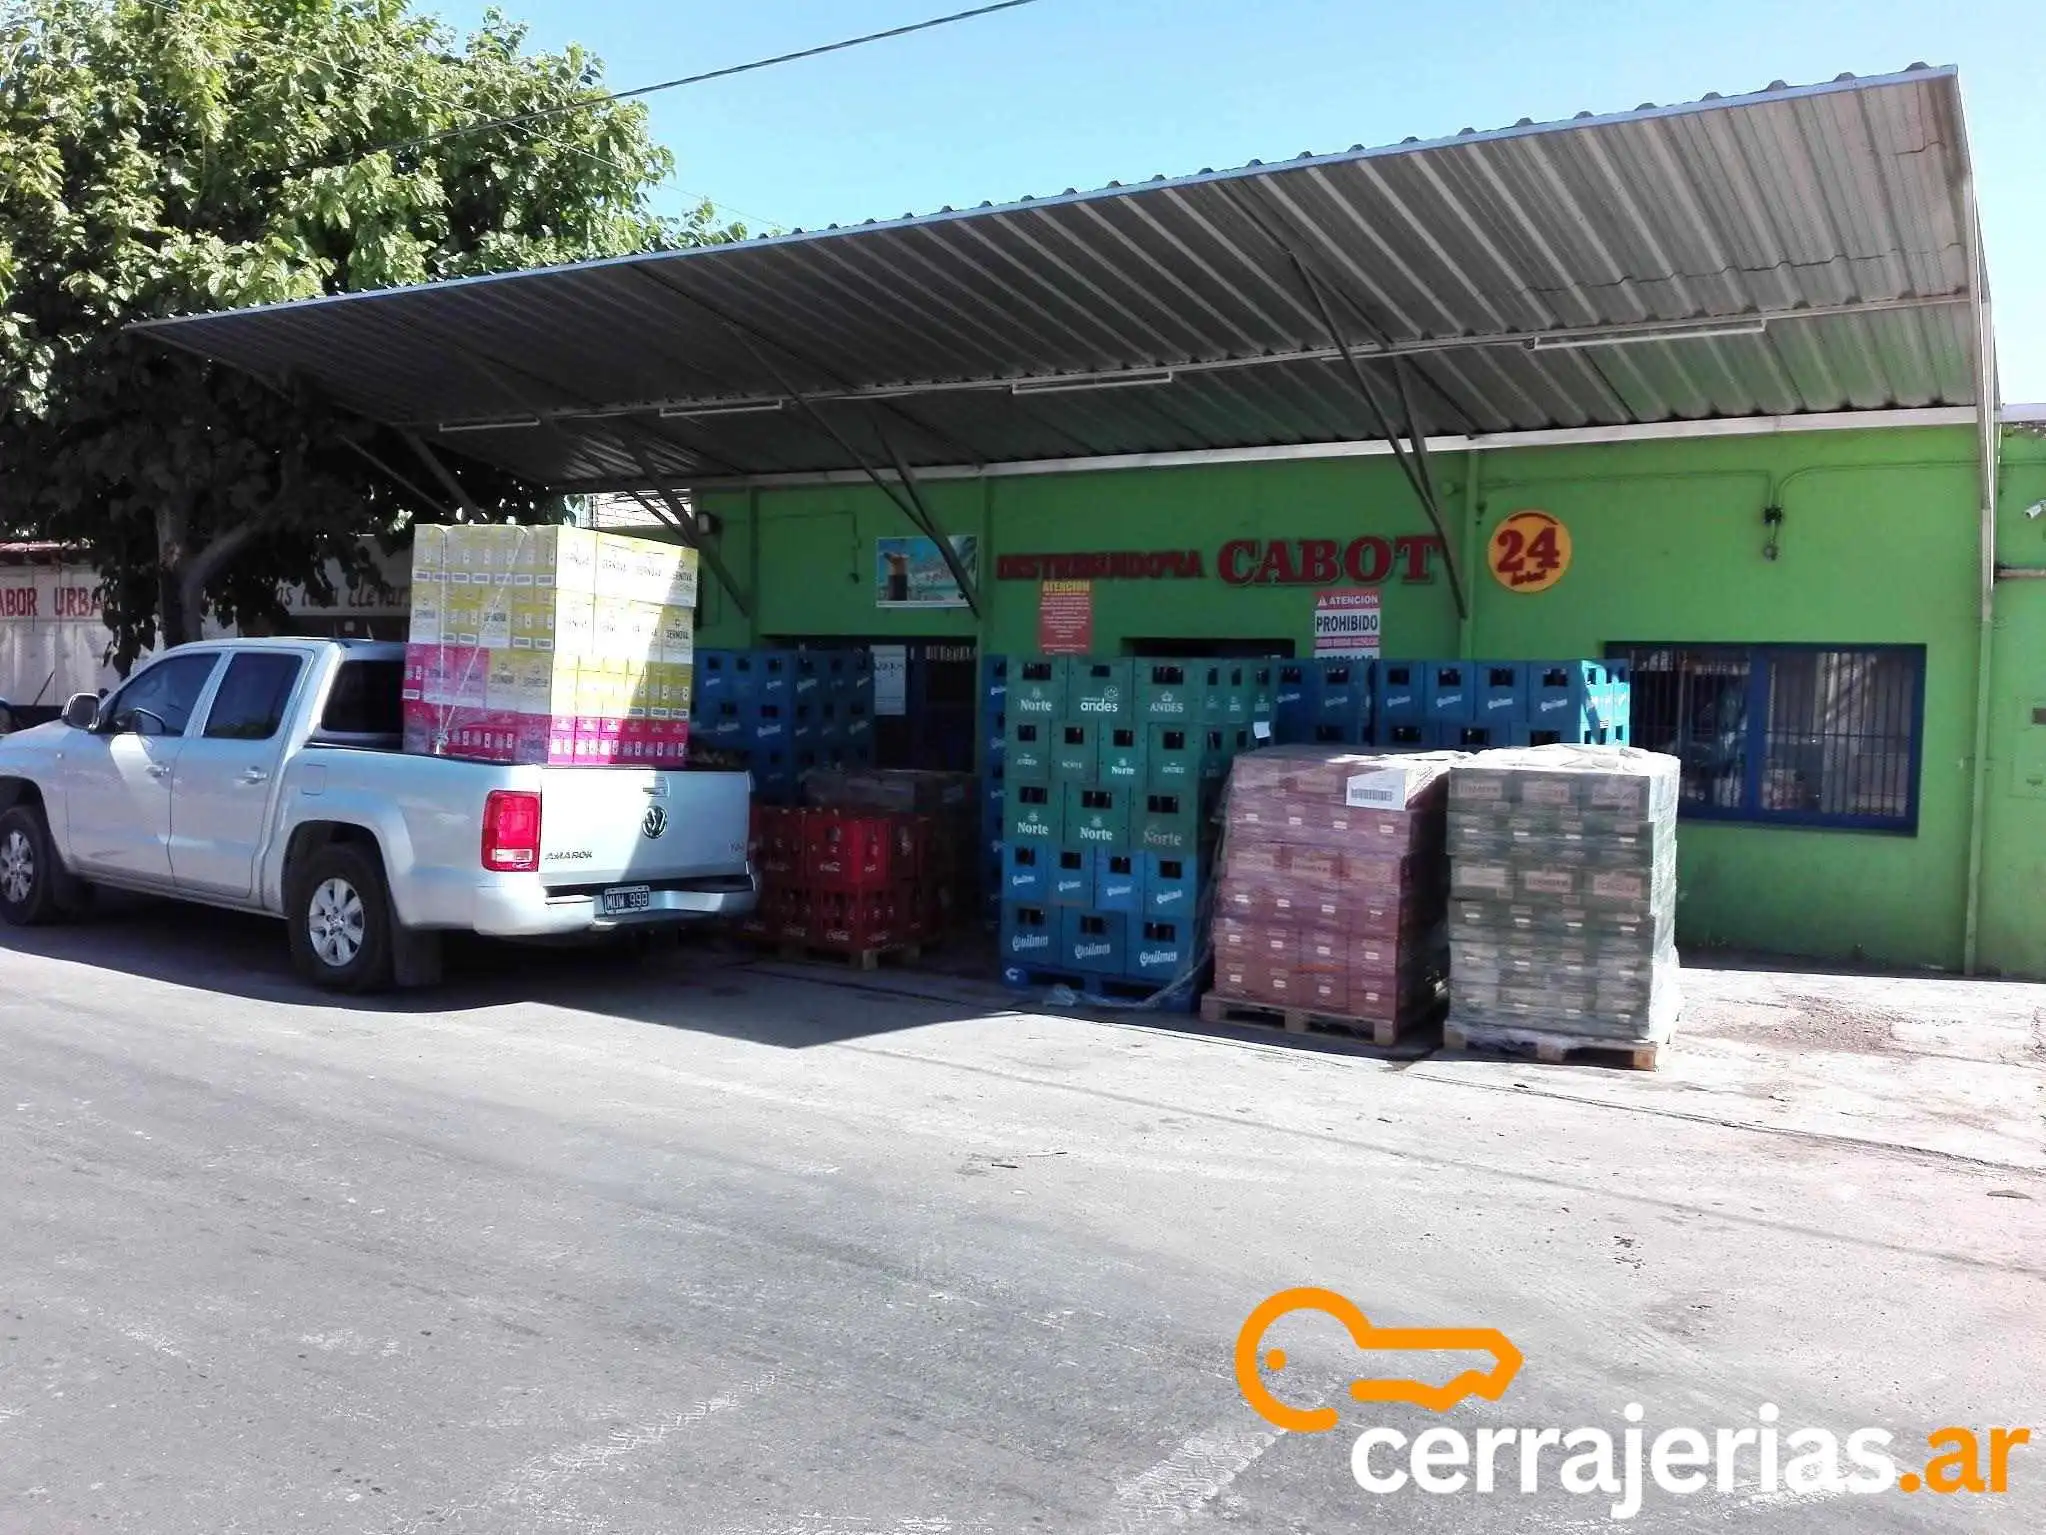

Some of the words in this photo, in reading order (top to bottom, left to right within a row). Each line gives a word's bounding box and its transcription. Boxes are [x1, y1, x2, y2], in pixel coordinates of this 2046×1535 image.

[1497, 527, 1560, 573] 24
[1217, 535, 1443, 585] CABOT
[1316, 614, 1378, 632] PROHIBIDO
[1020, 700, 1053, 712] Norte
[1080, 698, 1118, 712] andes
[1150, 702, 1184, 713] ANDES
[1111, 765, 1136, 776] Norte
[1017, 821, 1049, 836] Norte
[1079, 826, 1113, 841] Norte
[1143, 828, 1182, 846] Norte
[1012, 935, 1048, 951] Quilmes
[1139, 950, 1177, 967] Quilmes
